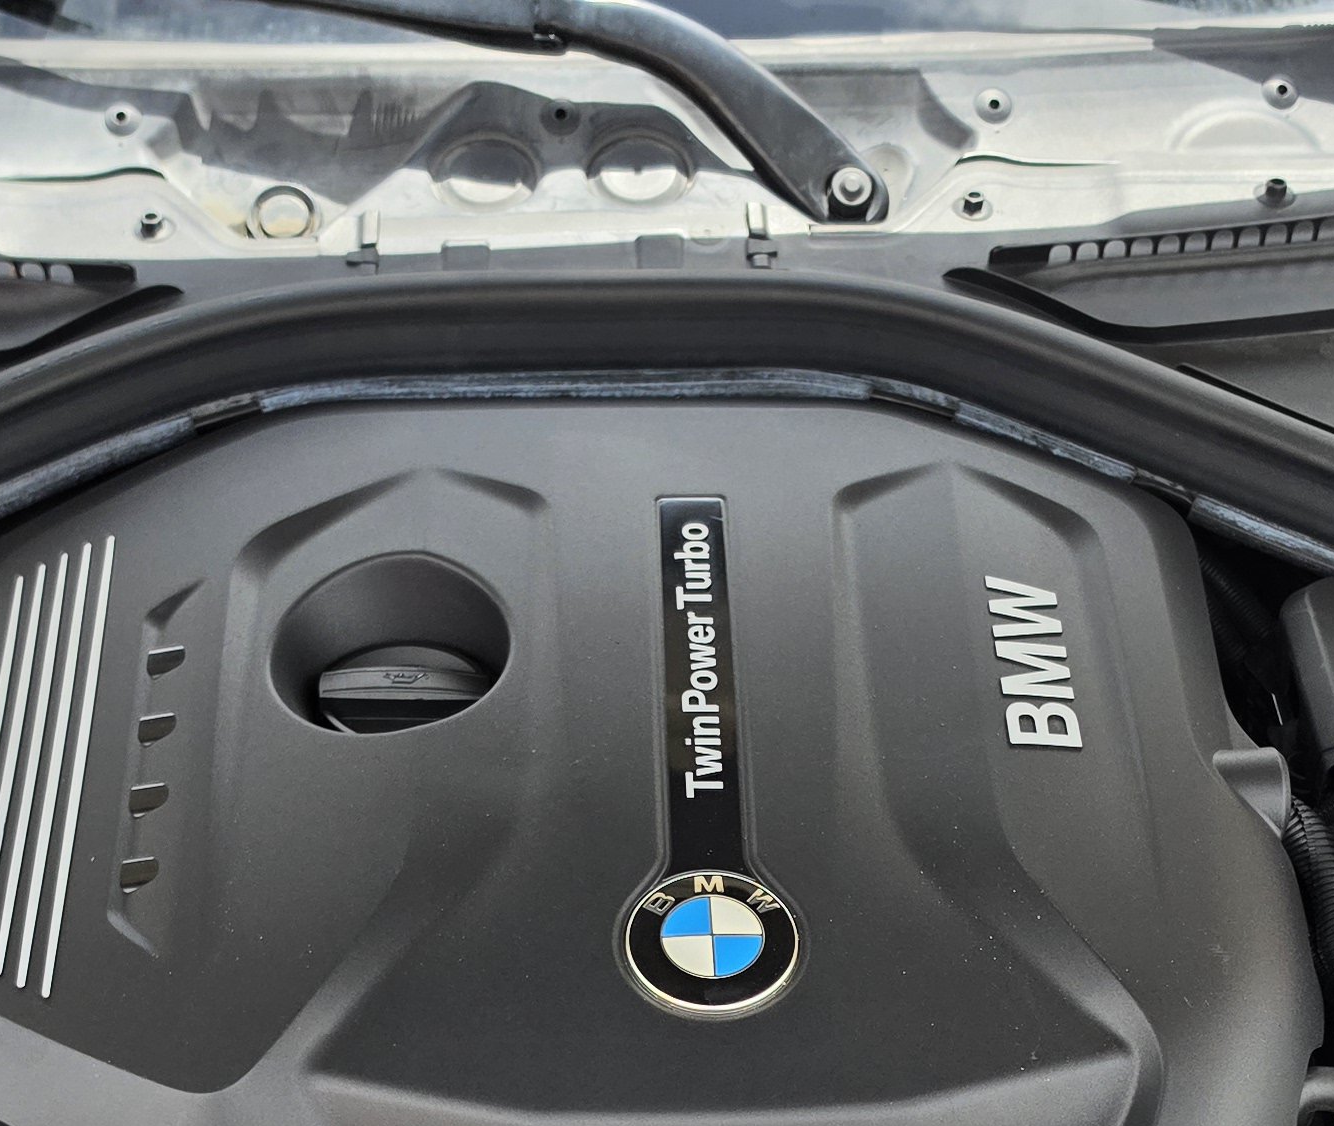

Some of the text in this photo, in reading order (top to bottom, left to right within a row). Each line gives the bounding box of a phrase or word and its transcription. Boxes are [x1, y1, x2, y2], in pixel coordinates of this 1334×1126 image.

[673, 522, 724, 799] TwinPower Turbo
[984, 574, 1083, 748] BMW
[642, 875, 781, 917] BMW
